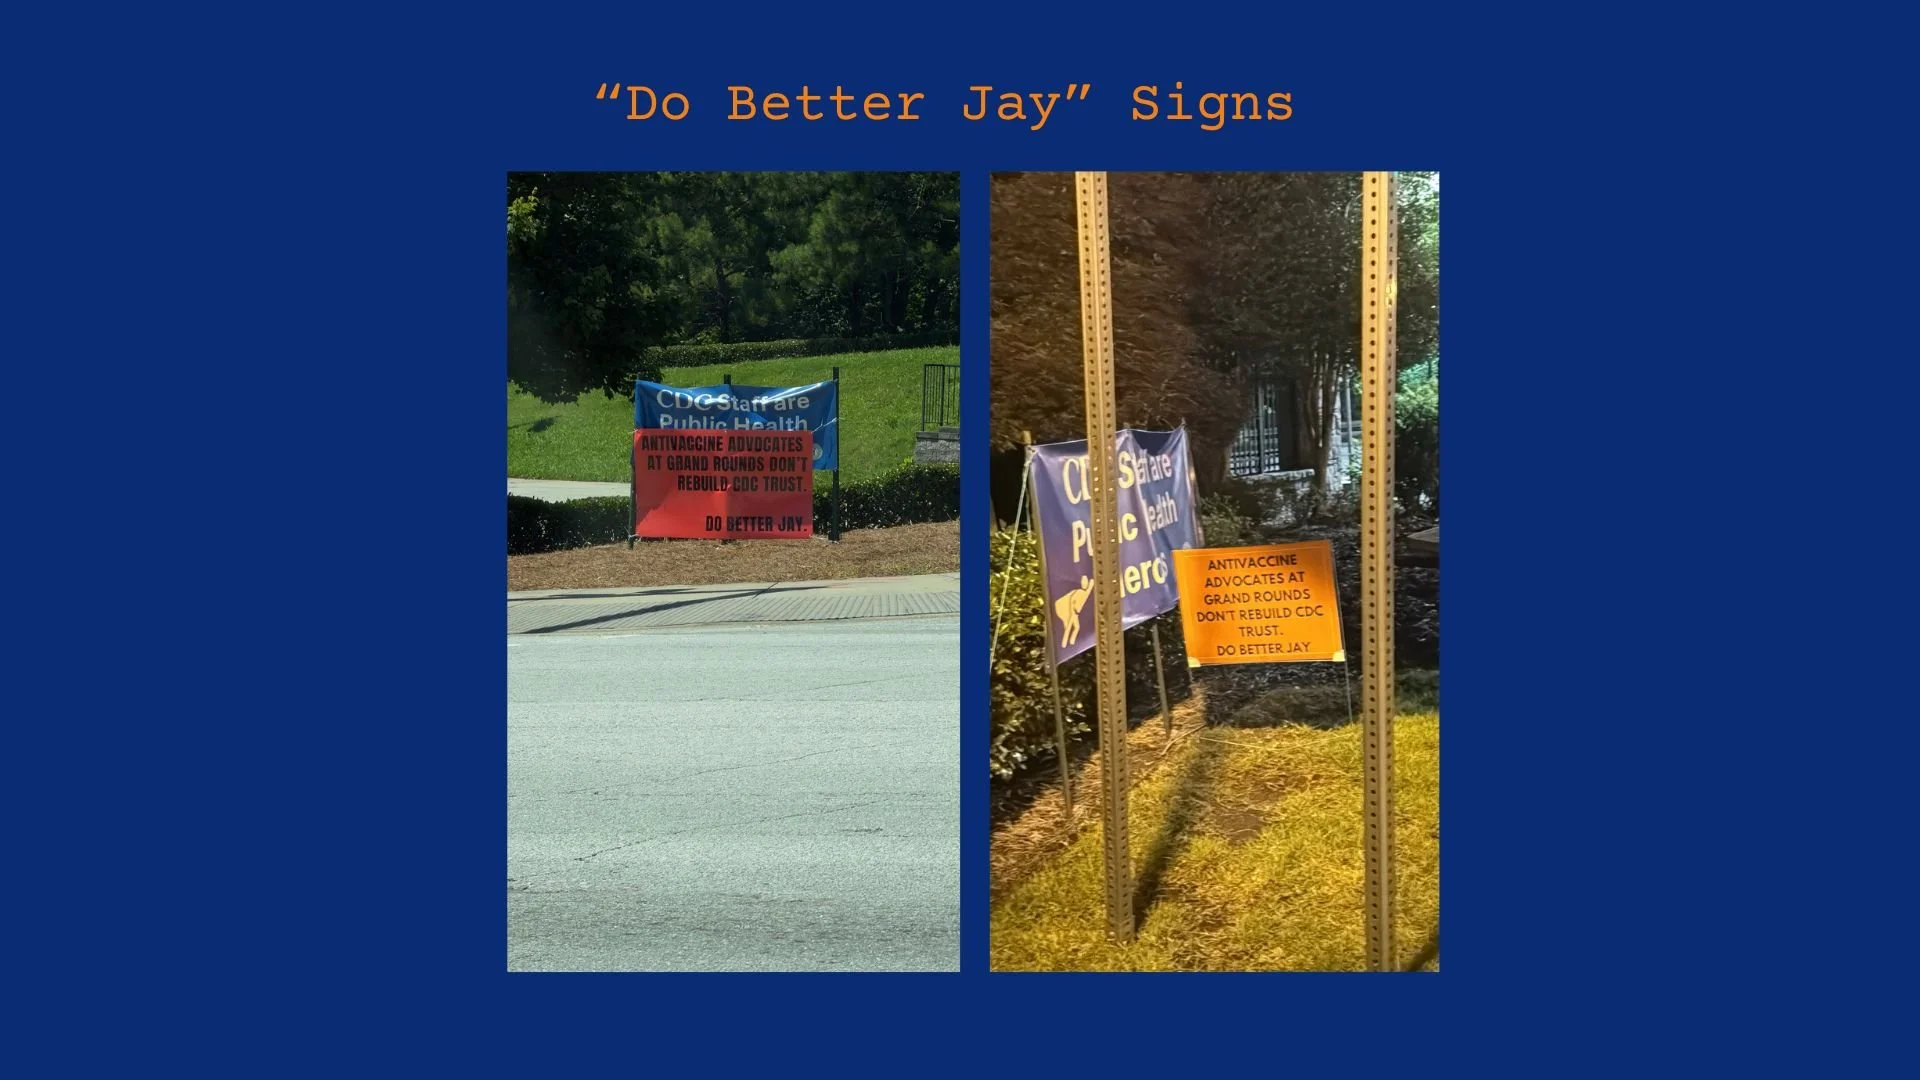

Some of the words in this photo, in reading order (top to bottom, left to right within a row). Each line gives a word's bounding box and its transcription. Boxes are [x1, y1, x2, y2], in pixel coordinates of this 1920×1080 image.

[656, 389, 712, 411] CDC
[717, 393, 768, 412] Staff
[774, 395, 810, 410] are
[659, 413, 727, 430] Public
[734, 415, 808, 431] Health
[641, 435, 723, 452] ANTIVACCINE
[727, 436, 804, 453] ADVOCATES
[647, 455, 662, 471] AT
[667, 455, 708, 471] GRAND
[713, 456, 764, 471] ROUNDS
[769, 456, 808, 472] DON'T
[1151, 453, 1172, 482] are
[677, 475, 727, 491] REBUILD
[733, 476, 758, 492] CDC
[763, 476, 807, 493] TRUST.
[705, 515, 722, 532] DO
[726, 516, 773, 532] BETTER
[778, 516, 808, 533] JAY.
[1208, 554, 1297, 571] ANTIVACCINE
[1204, 573, 1285, 588] ADVOCATES
[1288, 571, 1305, 584] AT
[1204, 592, 1250, 606] GRAND
[1254, 588, 1311, 602] ROUNDS
[1197, 610, 1235, 623] DON'T
[1239, 607, 1292, 621] REBUILD
[1296, 605, 1324, 617] CDC
[1238, 625, 1284, 638] TRUST.
[1217, 645, 1236, 657] DO
[1240, 643, 1284, 656] BETTER
[1287, 642, 1311, 654] JAY
